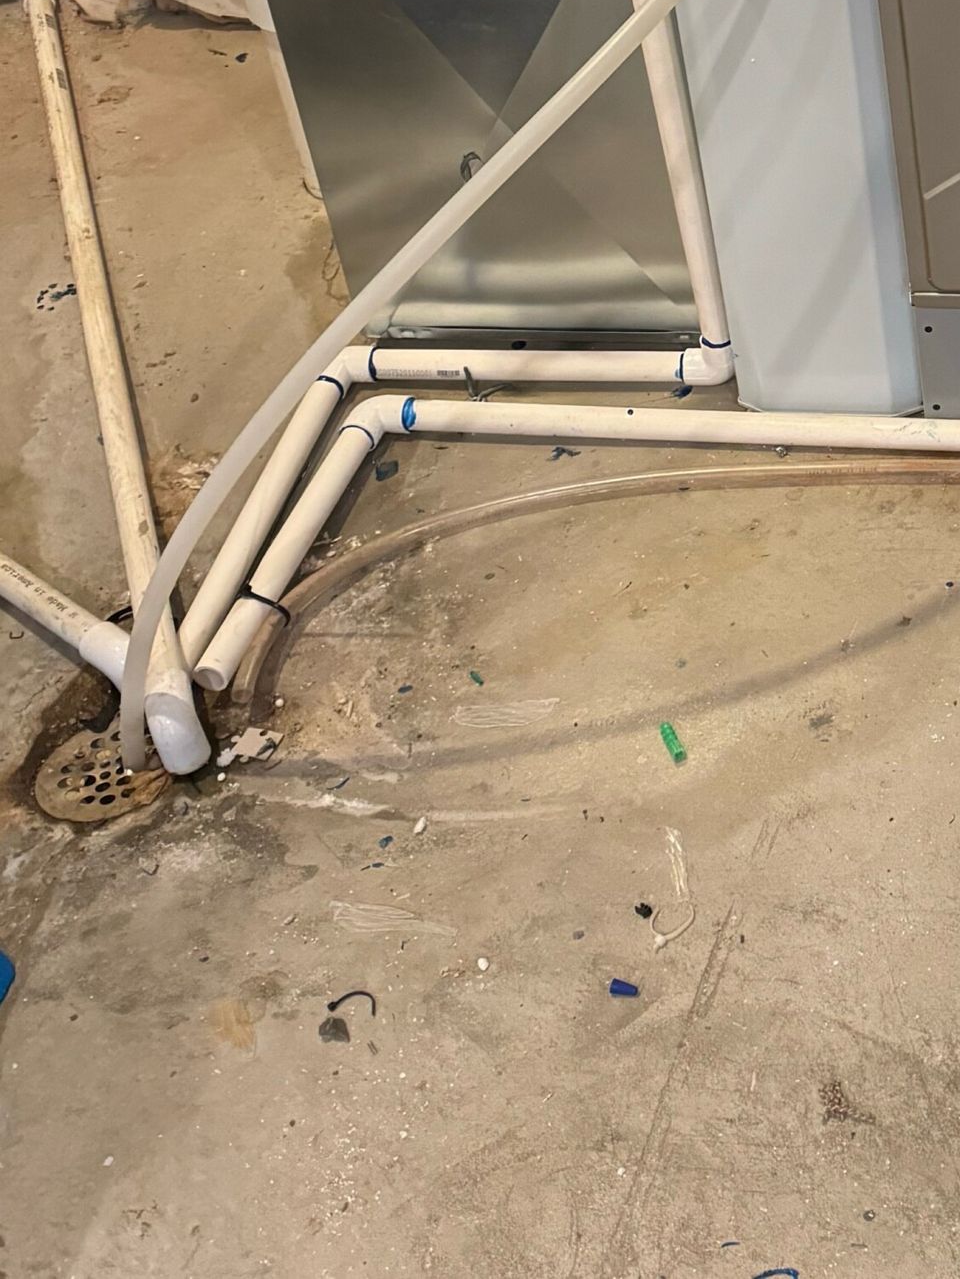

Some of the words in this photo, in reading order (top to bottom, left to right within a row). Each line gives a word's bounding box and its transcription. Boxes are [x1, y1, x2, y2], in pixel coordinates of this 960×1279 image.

[1, 564, 34, 588] America
[34, 586, 46, 595] in
[47, 596, 69, 612] Made
